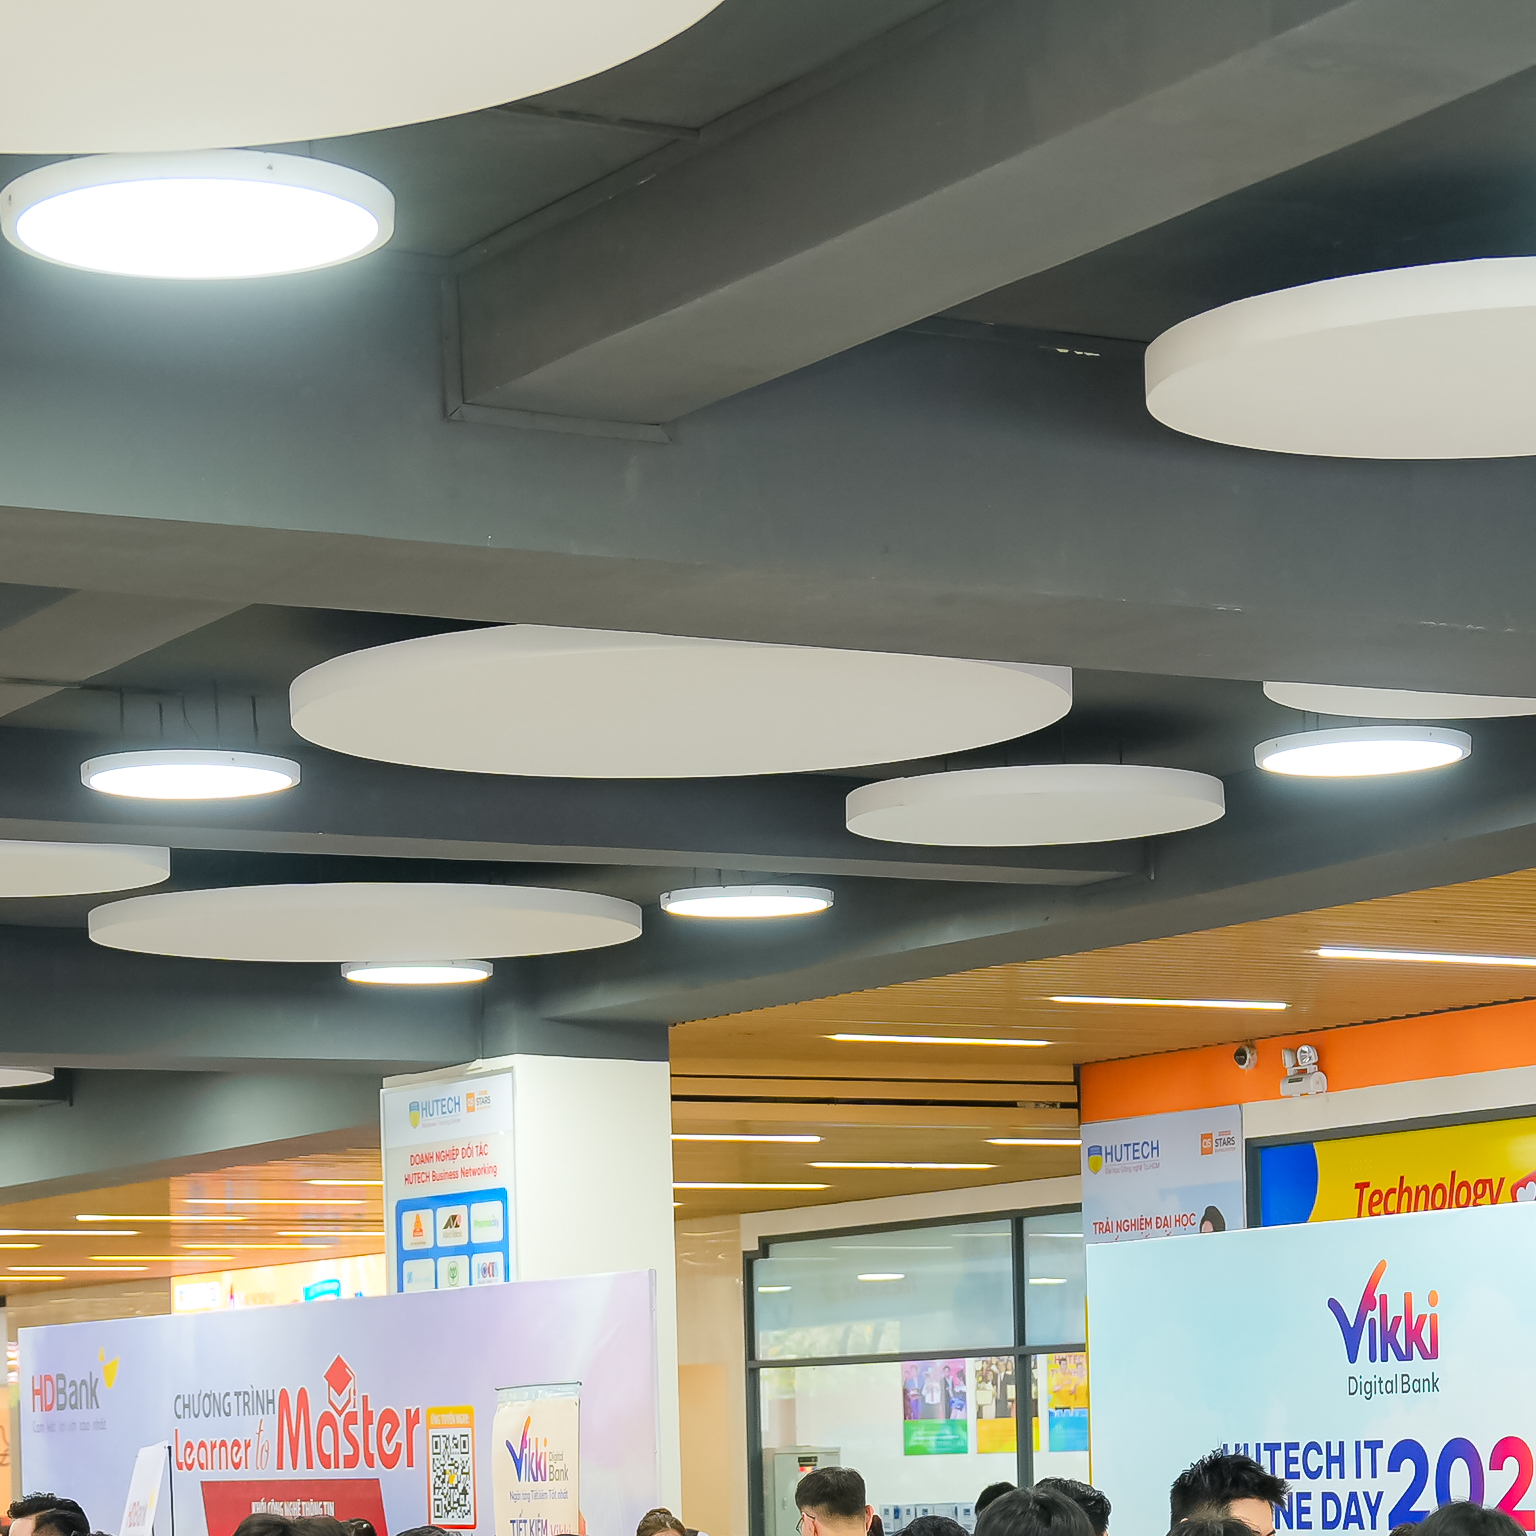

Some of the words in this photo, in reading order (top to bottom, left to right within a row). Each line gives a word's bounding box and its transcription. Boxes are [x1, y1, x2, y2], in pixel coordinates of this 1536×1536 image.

[421, 1096, 461, 1117] HUTECH
[410, 1152, 435, 1166] DOANH
[435, 1148, 460, 1164] NGHIỆP
[461, 1141, 474, 1159] ĐỐI
[475, 1142, 489, 1156] TÁC
[1104, 1140, 1160, 1163] HUTECH
[1215, 1136, 1236, 1148] STARS
[404, 1171, 431, 1186] HUTECH
[431, 1167, 459, 1182] Business
[460, 1161, 498, 1180] Networking
[1354, 1169, 1505, 1219] Technology
[1093, 1217, 1114, 1235] TRẢI
[1116, 1215, 1153, 1235] NGHIỆM
[1155, 1214, 1172, 1233] ĐẠI
[1174, 1212, 1197, 1231] HỌC
[1327, 1258, 1440, 1365] Vikki
[31, 1371, 100, 1412] HDBank
[174, 1389, 232, 1419] CHƯƠNG
[234, 1385, 276, 1416] TRÌNH
[1348, 1373, 1398, 1401] Digital
[1401, 1371, 1440, 1394] Bank
[174, 1428, 251, 1471] Learner
[255, 1418, 270, 1470] to
[276, 1386, 421, 1471] Master
[506, 1415, 547, 1482] Vikki
[1355, 1440, 1384, 1480] IT
[549, 1464, 569, 1482] Bank
[1272, 1491, 1313, 1530] NE
[1322, 1490, 1384, 1530] DAY
